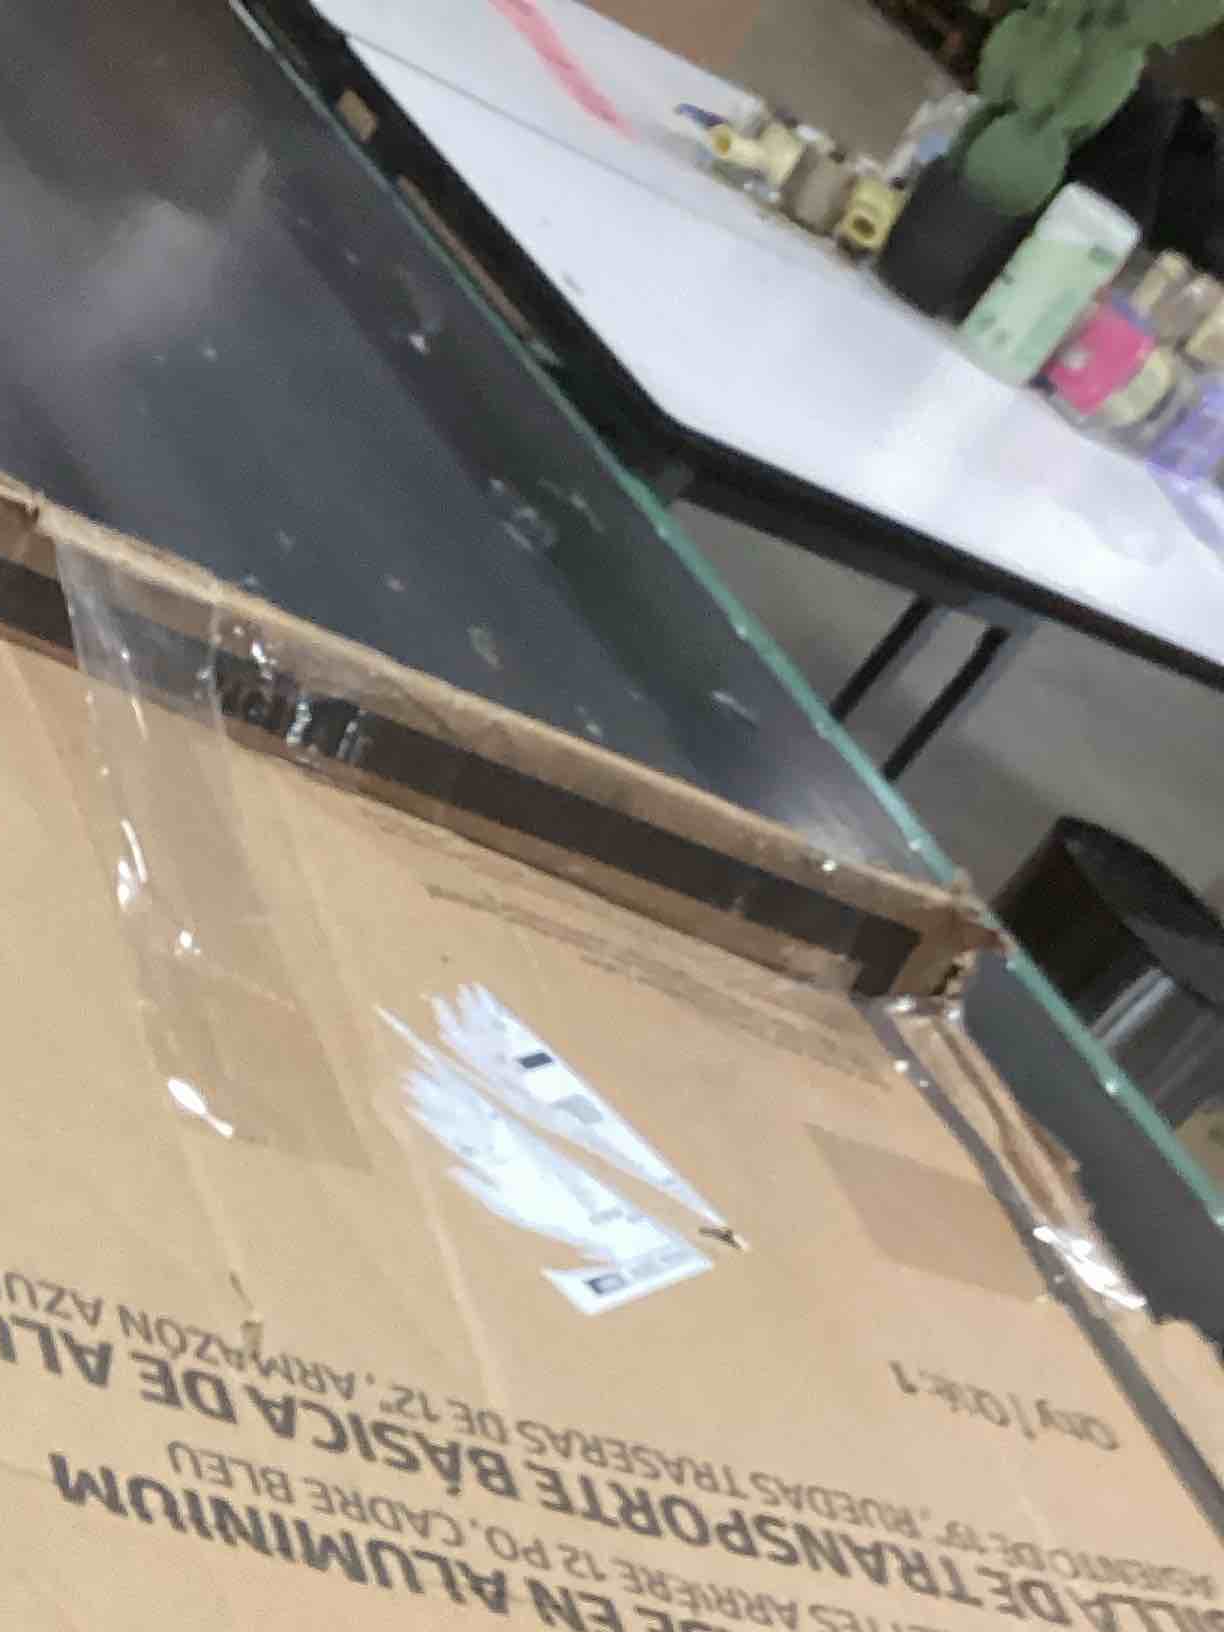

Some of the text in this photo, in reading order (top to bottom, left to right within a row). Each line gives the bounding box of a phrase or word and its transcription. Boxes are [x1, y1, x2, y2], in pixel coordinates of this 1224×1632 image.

[129, 1351, 239, 1426] DE
[446, 1398, 510, 1447] DE
[166, 1440, 295, 1506] BLEU
[242, 1384, 522, 1502] BÁSICA
[514, 1420, 749, 1502] TRASERAS
[47, 1452, 512, 1617] ALUMINIUM
[302, 1475, 465, 1549] CADRE
[522, 1459, 984, 1611] TRANSPORTE
[747, 1471, 922, 1541] RUEDAS
[555, 1542, 608, 1583] 12
[974, 1566, 1074, 1630] DE
